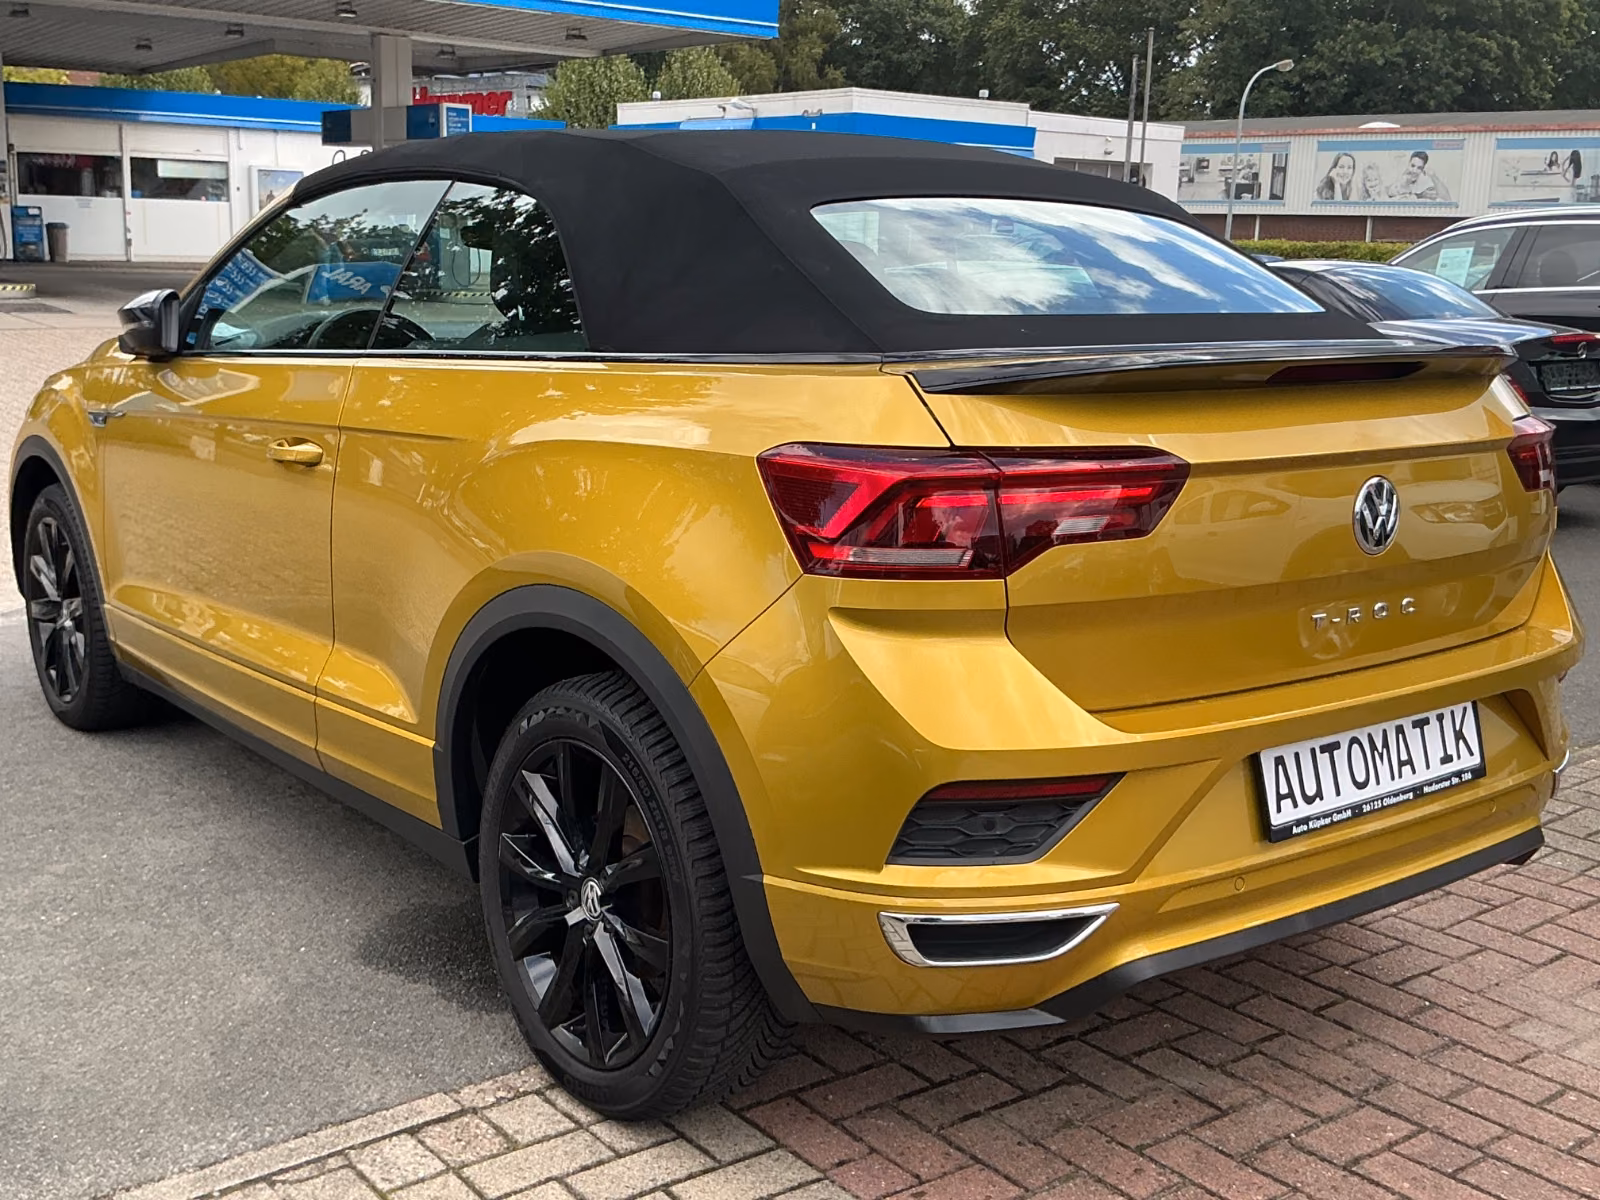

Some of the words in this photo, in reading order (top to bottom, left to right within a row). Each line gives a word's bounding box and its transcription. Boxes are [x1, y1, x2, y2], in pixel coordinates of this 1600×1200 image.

[1311, 598, 1416, 632] T-ROC
[1274, 706, 1475, 814] AUTOMATIK
[1292, 824, 1308, 834] Auto
[1332, 808, 1352, 822] GmbH
[1383, 790, 1414, 806] Oldenburg
